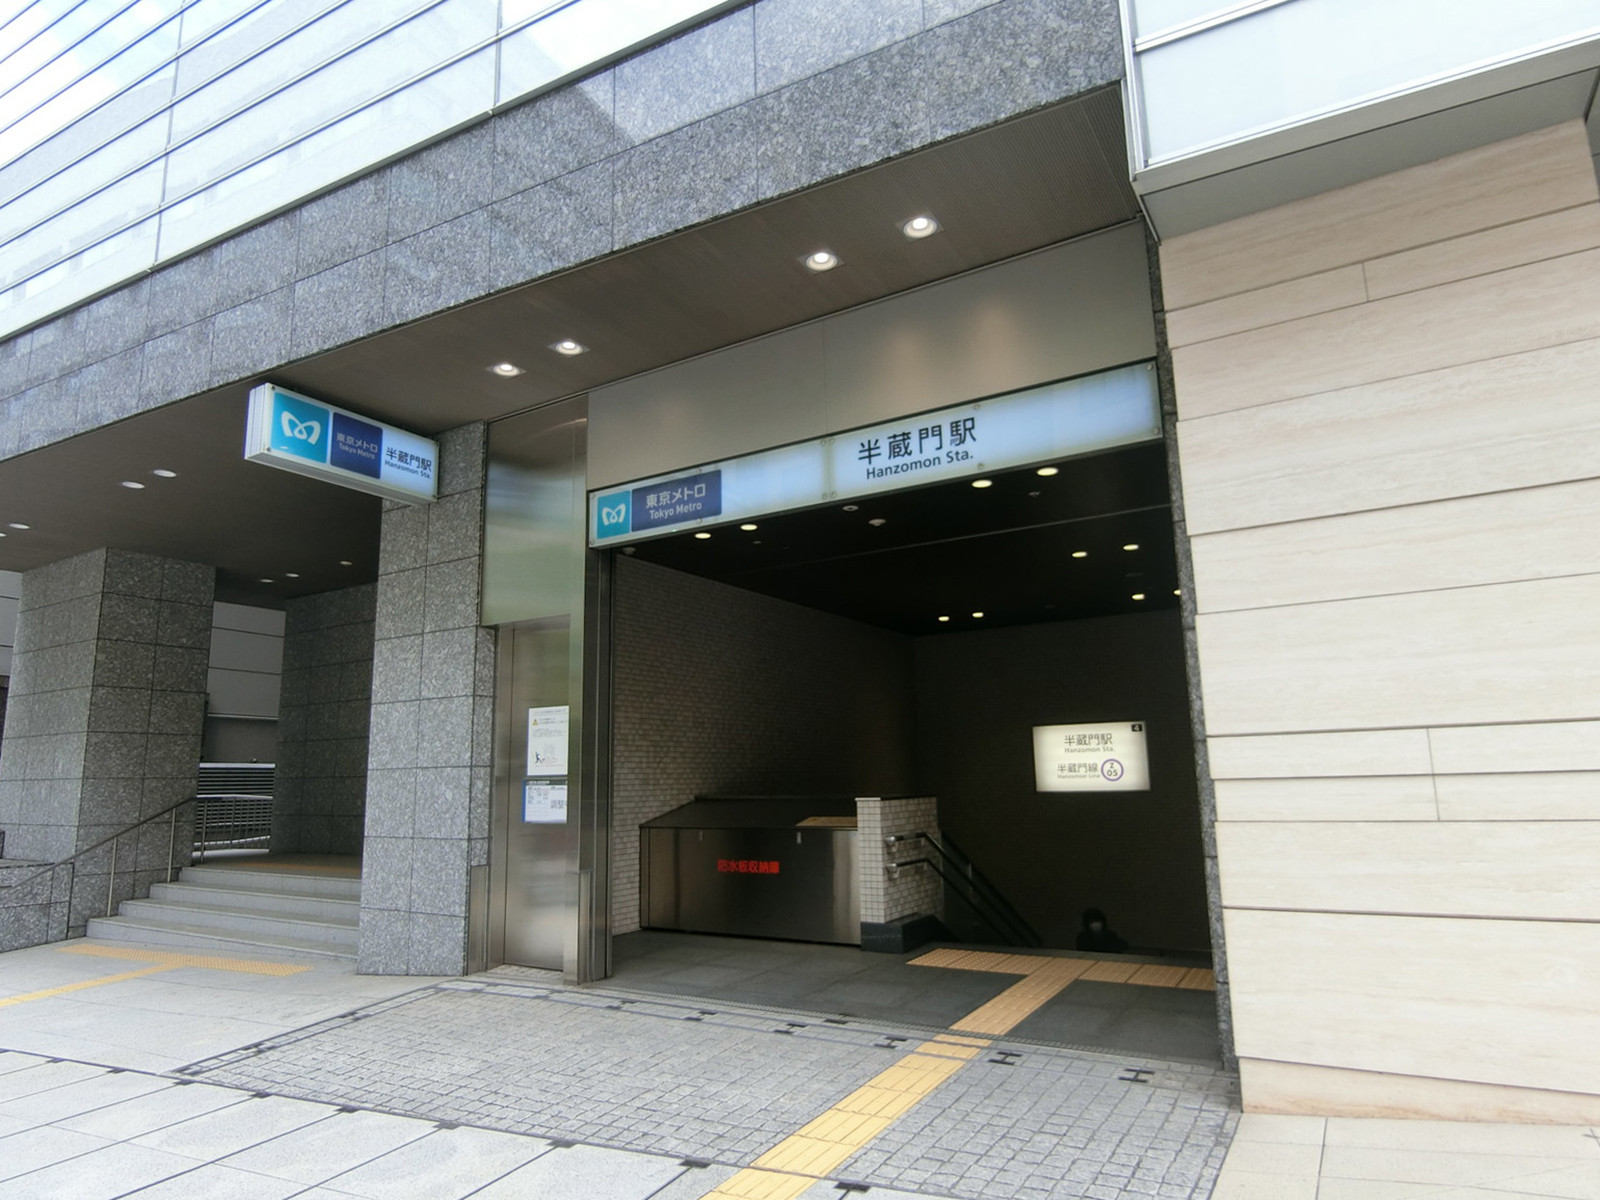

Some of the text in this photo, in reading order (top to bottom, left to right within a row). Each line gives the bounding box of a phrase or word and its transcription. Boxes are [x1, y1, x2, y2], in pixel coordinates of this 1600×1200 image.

[336, 432, 378, 454] 東京メトロ
[858, 417, 977, 465] 半蔵門駅
[339, 443, 375, 460] Tokyo Metro
[386, 447, 432, 471] 半蔵門駅
[385, 460, 419, 475] Hanzomon
[866, 448, 974, 479] Hanzomon Sta.
[646, 483, 706, 509] 東京メトロ
[649, 502, 702, 520] Tokyo Metro
[1064, 733, 1113, 746] 半蔵門駅
[1057, 763, 1098, 773] 半蔵門線
[1107, 769, 1118, 777] 05
